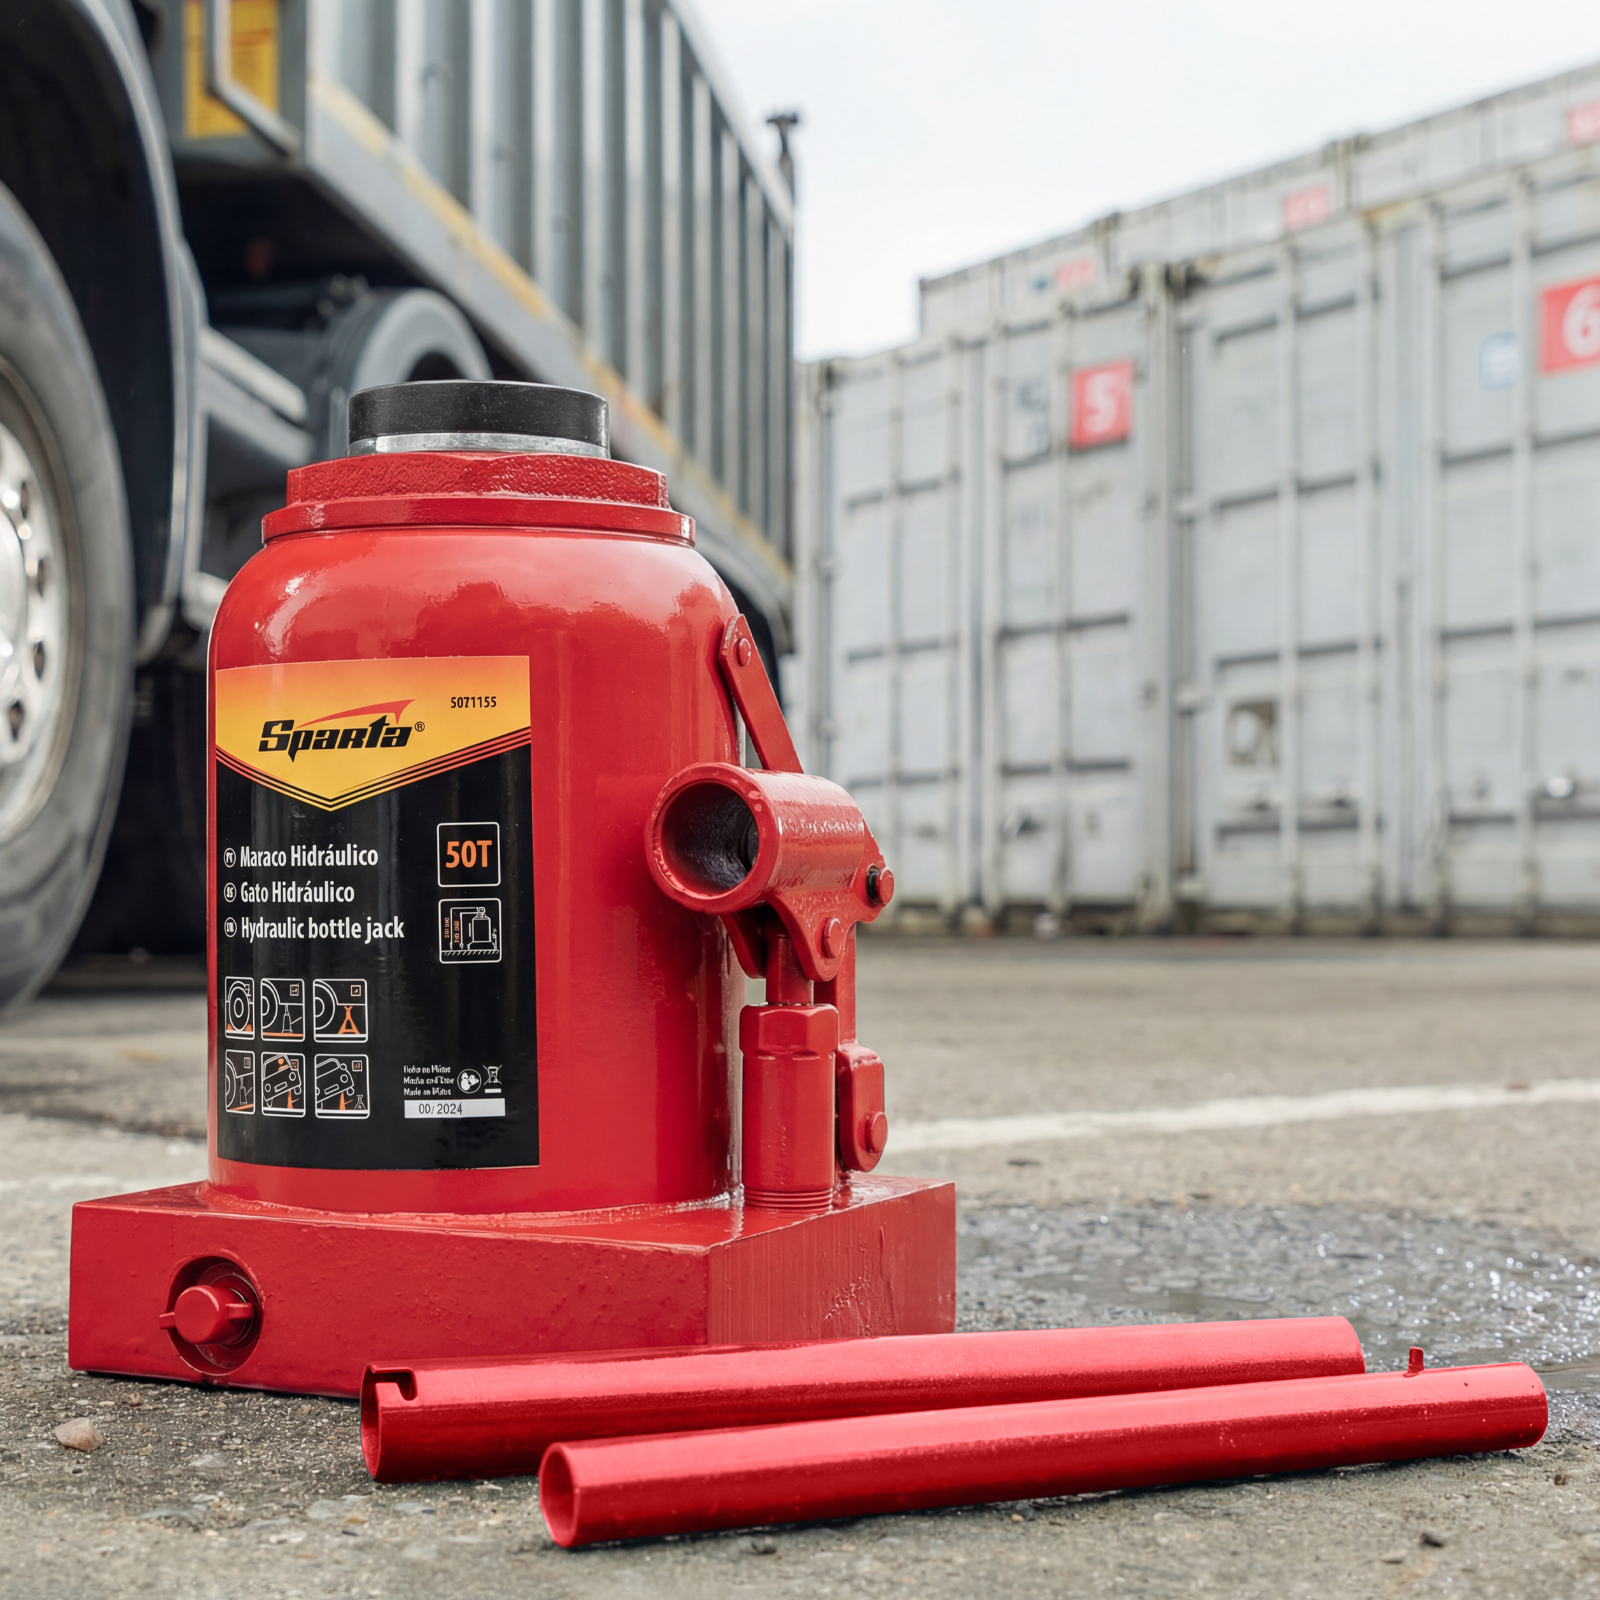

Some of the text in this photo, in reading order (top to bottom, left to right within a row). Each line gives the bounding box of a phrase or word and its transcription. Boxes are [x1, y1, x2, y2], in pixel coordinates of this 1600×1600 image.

[1563, 284, 1600, 358] 6
[450, 696, 497, 709] 5071155
[240, 845, 287, 867] Maraco
[290, 844, 379, 867] Hidráulico
[445, 839, 493, 868] 50T
[240, 881, 269, 903] Gato
[271, 881, 355, 903] Hidráulico
[241, 916, 305, 944] Hydraulic
[308, 916, 362, 939] bottle
[364, 915, 405, 945] jack
